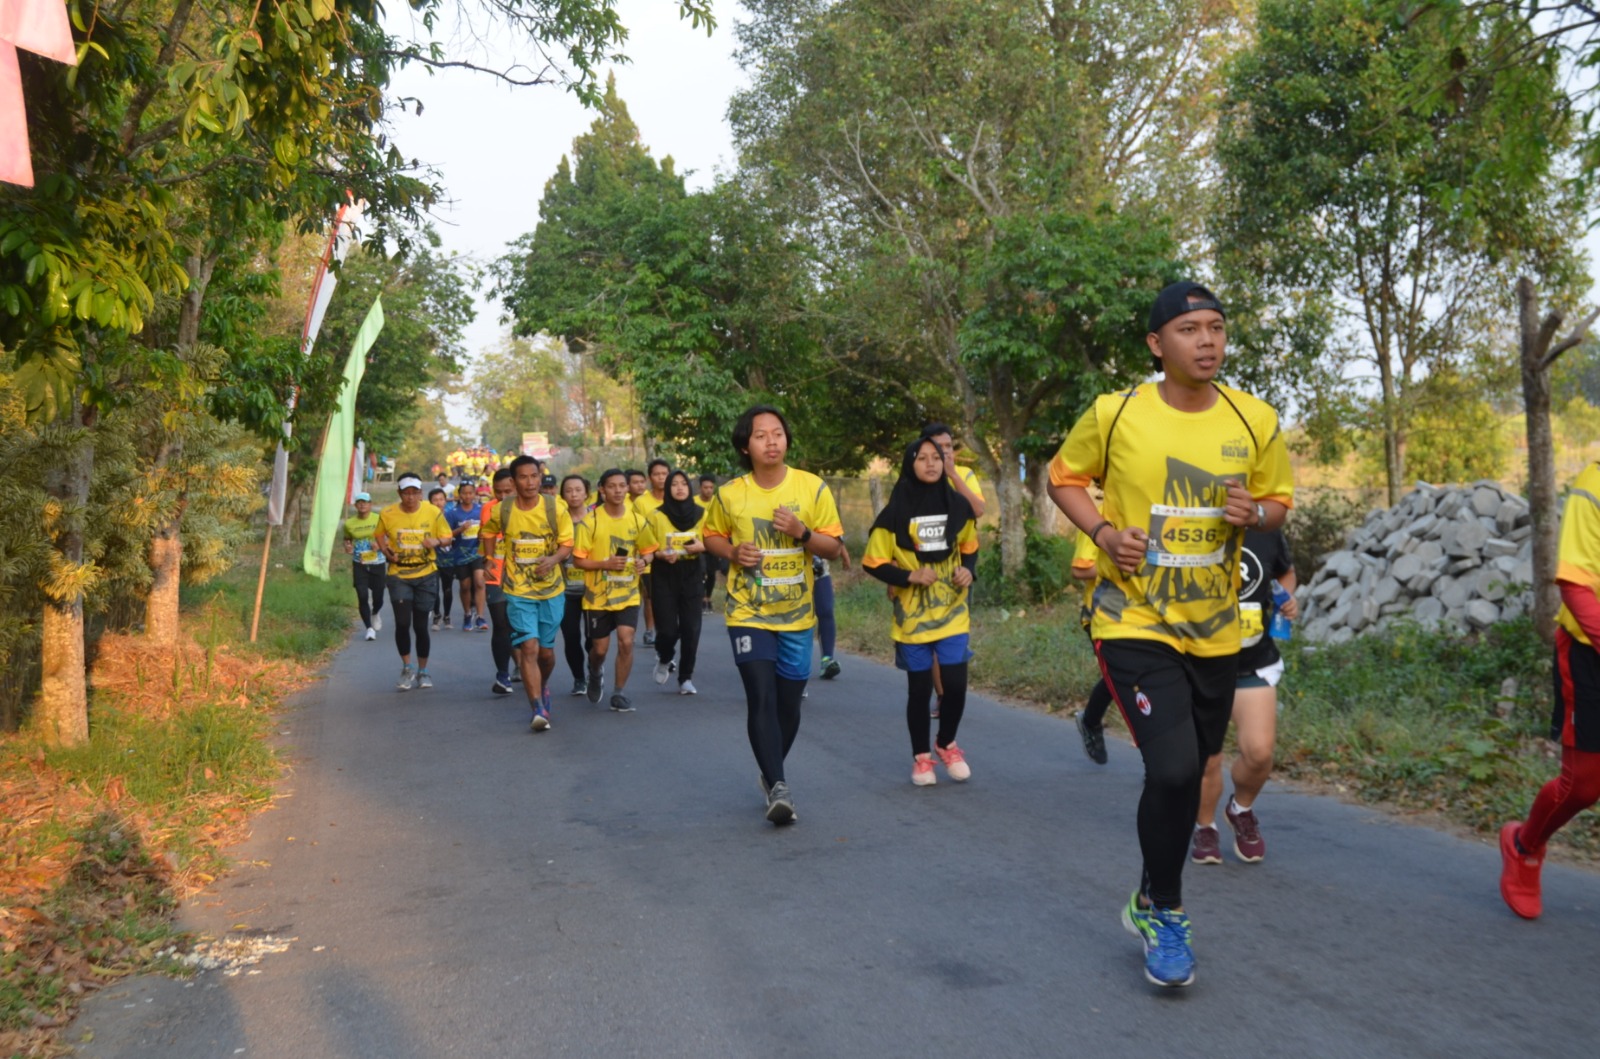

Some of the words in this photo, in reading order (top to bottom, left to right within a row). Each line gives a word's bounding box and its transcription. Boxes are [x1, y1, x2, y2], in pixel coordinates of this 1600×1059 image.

[918, 525, 946, 538] 4017
[1163, 528, 1217, 543] 4536
[763, 560, 797, 571] 4423
[735, 635, 753, 655] 13
